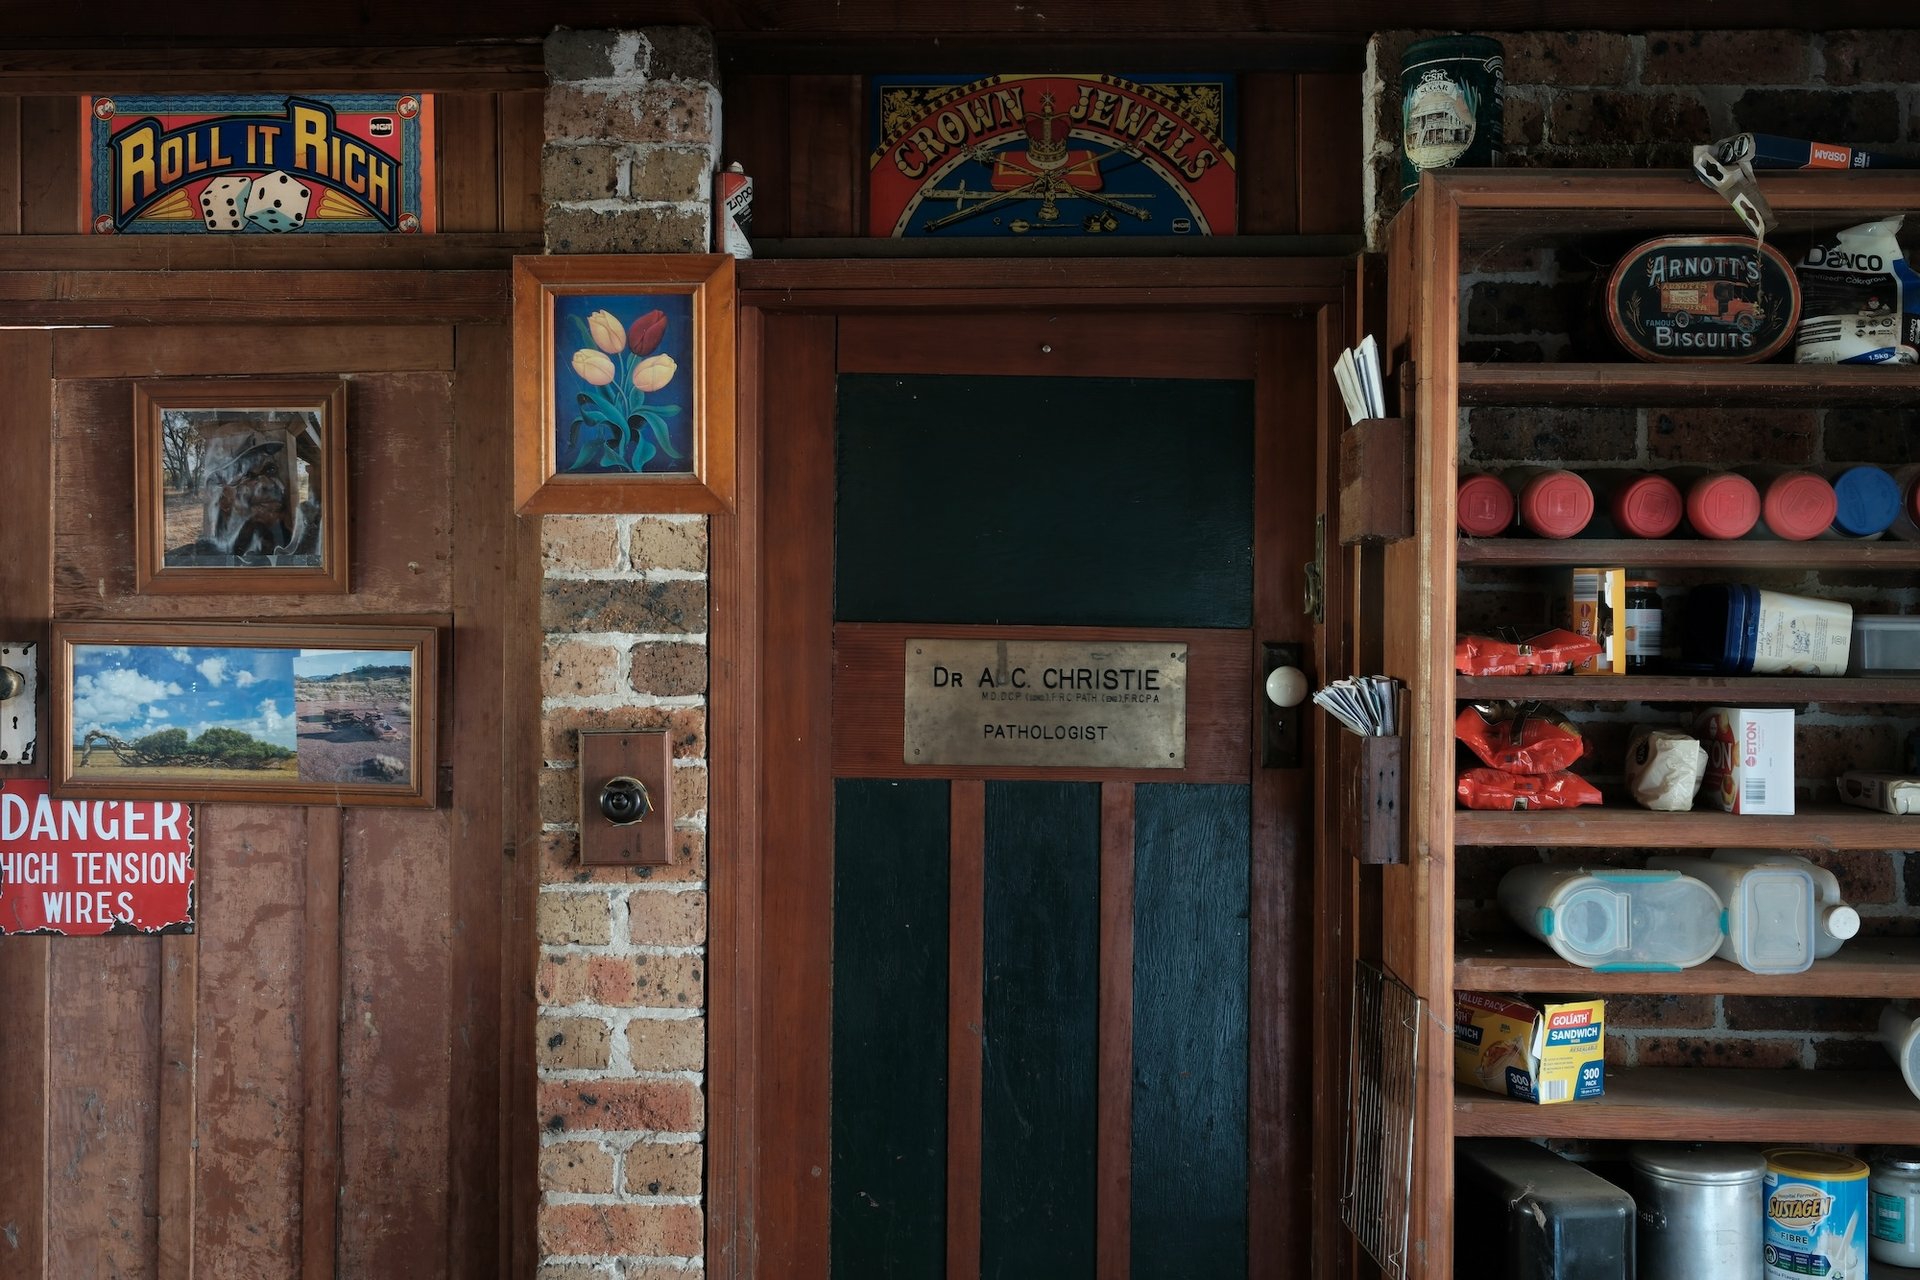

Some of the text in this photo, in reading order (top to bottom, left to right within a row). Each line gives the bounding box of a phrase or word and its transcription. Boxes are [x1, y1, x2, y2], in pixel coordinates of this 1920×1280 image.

[1424, 72, 1443, 82] CSR
[894, 85, 1218, 179] CROWN JEWELS
[119, 106, 390, 216] ROLL IT RICH
[1814, 149, 1847, 163] OSRAM
[1648, 254, 1760, 288] ARNOTT'S
[1646, 319, 1676, 327] FAMOUS
[1656, 326, 1753, 348] BISCUITS
[1868, 353, 1889, 361] 1.5kg
[1011, 667, 1031, 689] C.
[1043, 668, 1160, 690] CHRISTIE
[984, 724, 1109, 741] PATHOLOGIST
[1, 794, 182, 841] DANGER
[0, 852, 186, 885] HIGH TENSION
[42, 891, 143, 923] WIRES.
[1458, 991, 1507, 1011] VALUE PACK
[1551, 1026, 1598, 1041] SANDWICH
[1509, 1072, 1529, 1087] 300
[1583, 1067, 1600, 1080] 300
[1585, 1079, 1597, 1087] PACK
[1768, 1196, 1831, 1219] SUSTAGEN
[1780, 1231, 1809, 1245] FIBRE
